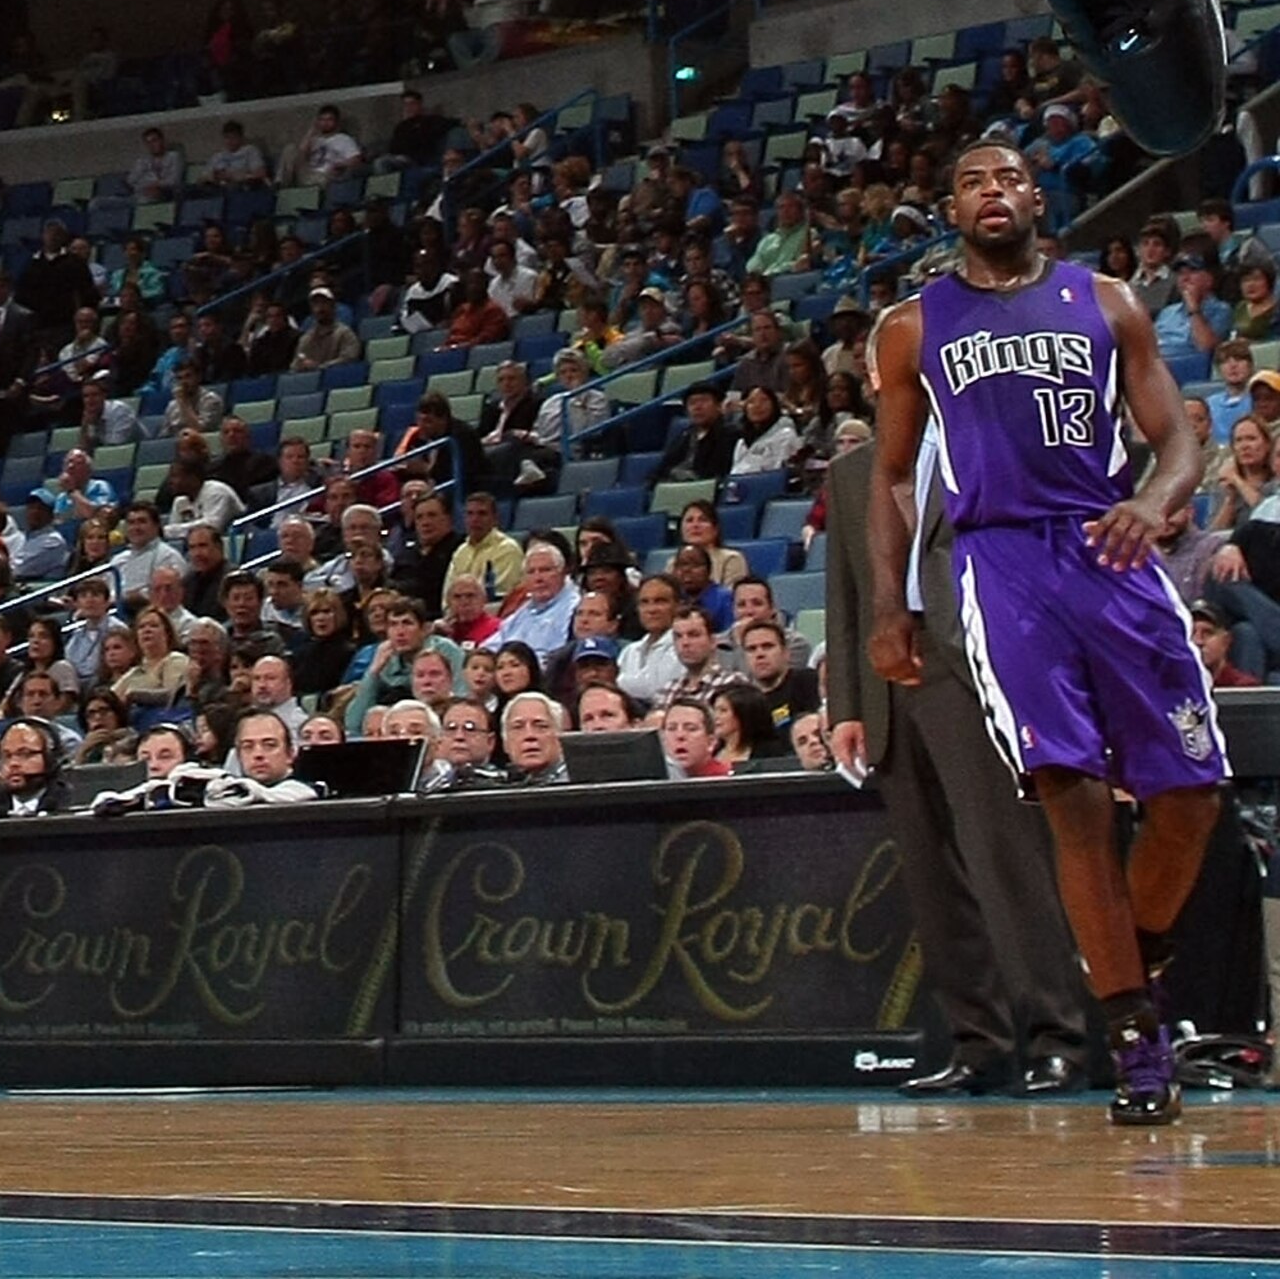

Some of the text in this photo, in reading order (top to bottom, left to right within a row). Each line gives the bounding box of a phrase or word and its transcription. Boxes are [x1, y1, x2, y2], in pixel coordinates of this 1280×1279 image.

[940, 330, 1094, 396] Kings
[1032, 388, 1096, 447] 13
[110, 843, 368, 1025] Royal
[420, 820, 899, 1022] Crown Royal
